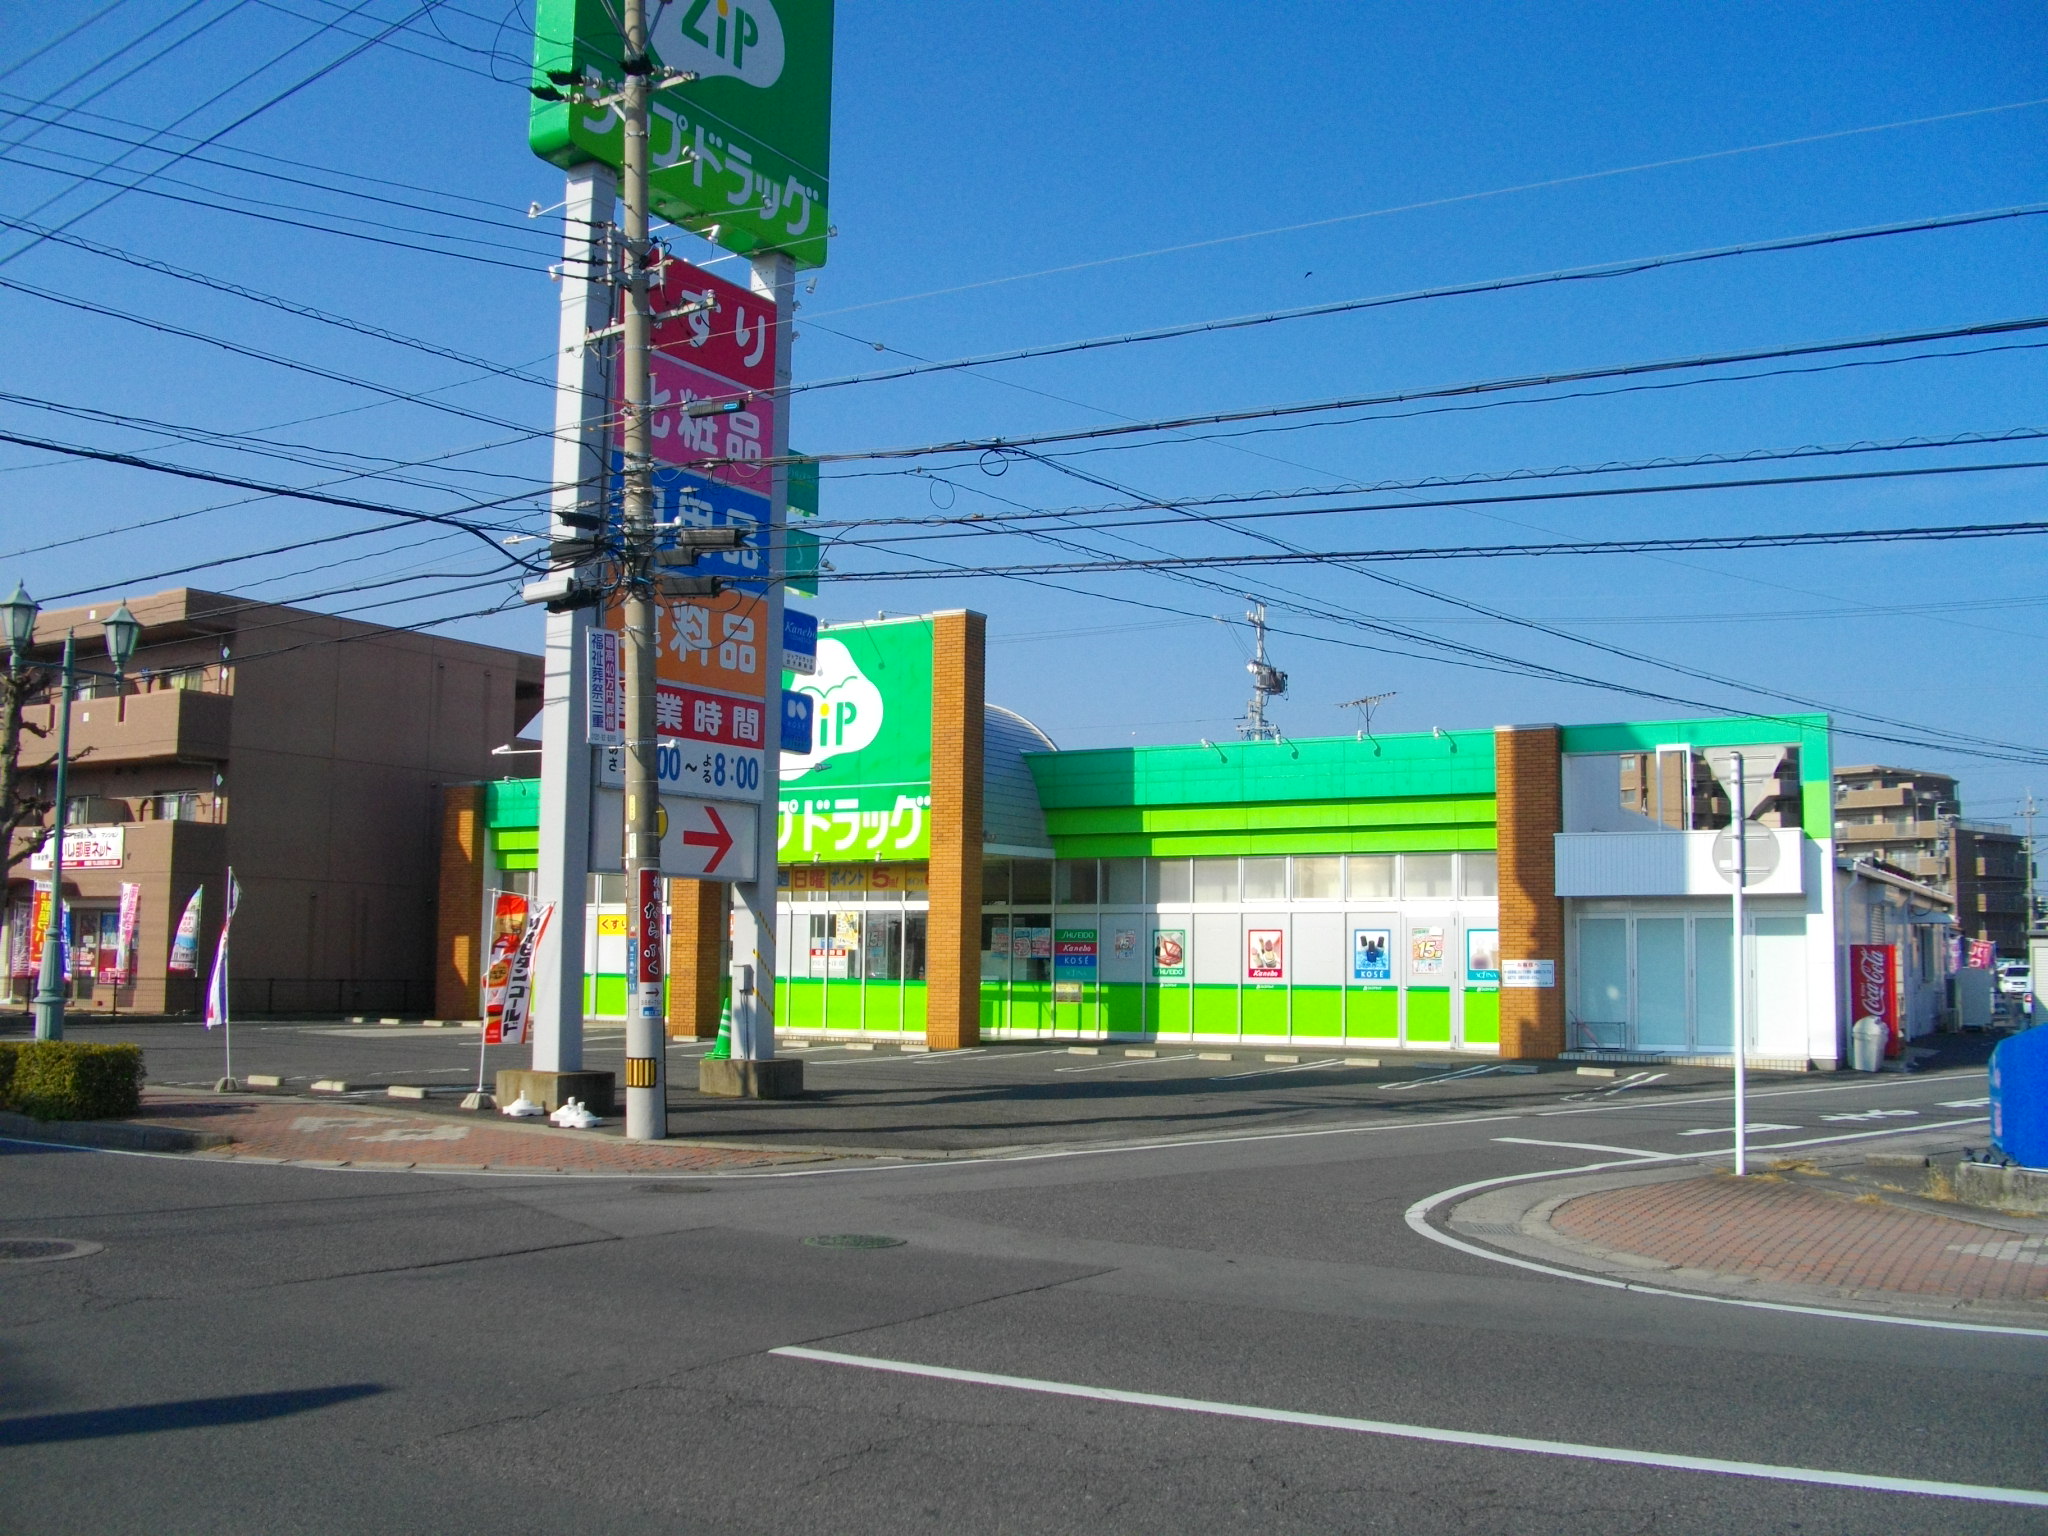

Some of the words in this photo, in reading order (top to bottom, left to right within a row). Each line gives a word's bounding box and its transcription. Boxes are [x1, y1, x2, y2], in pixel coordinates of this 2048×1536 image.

[651, 290, 766, 368] すり
[654, 490, 759, 570] 用品
[645, 600, 756, 674] 料品
[619, 690, 759, 742] 業時間
[714, 752, 759, 790] 8:00
[1063, 944, 1092, 952] Kanebo
